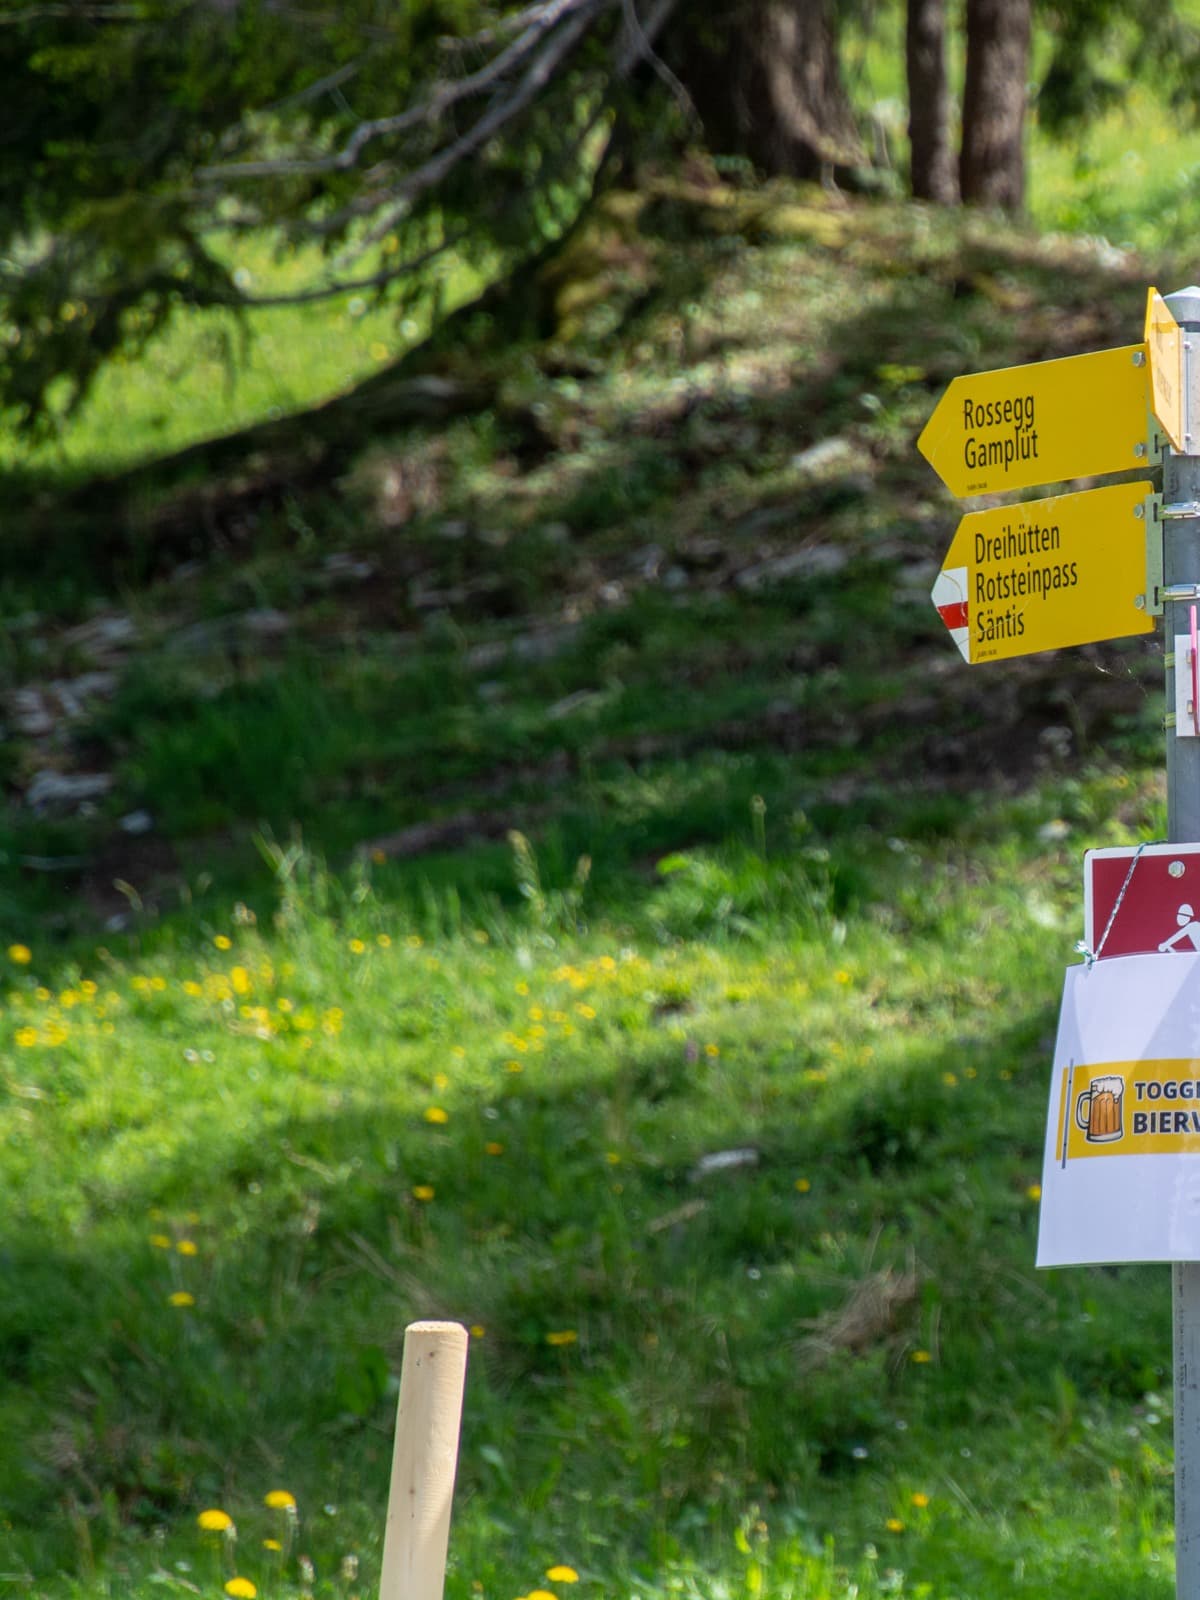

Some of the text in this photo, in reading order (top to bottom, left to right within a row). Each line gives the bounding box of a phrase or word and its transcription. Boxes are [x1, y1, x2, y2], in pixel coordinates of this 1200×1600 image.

[963, 395, 1035, 432] Rossegg
[964, 427, 1039, 472] Gamplüt
[975, 524, 1061, 564] Dreihütten
[976, 562, 1079, 604] Rotsteinpass
[976, 605, 1025, 643] Säntis
